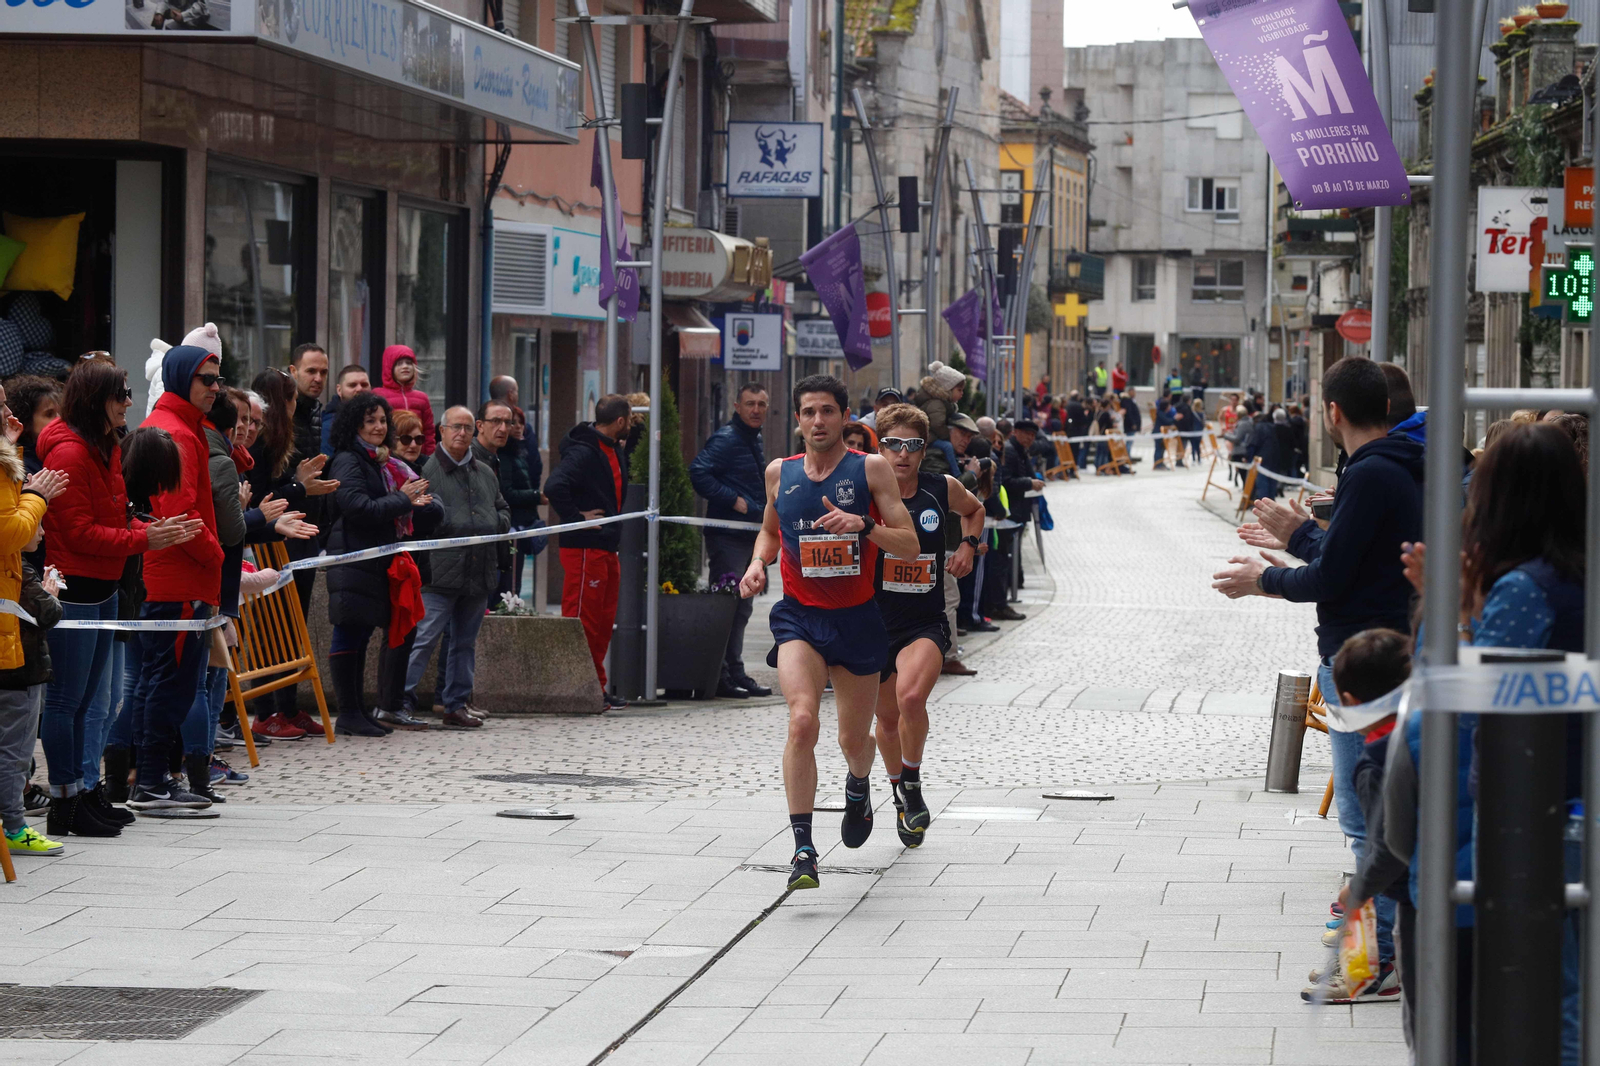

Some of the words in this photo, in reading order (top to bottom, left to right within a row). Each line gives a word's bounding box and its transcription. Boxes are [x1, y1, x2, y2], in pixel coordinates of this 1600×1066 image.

[1251, 7, 1296, 25] IGUALDADE
[1261, 17, 1296, 33] CULTURA
[1258, 22, 1310, 44] VISIBILIDADE
[1290, 131, 1304, 143] AS
[1305, 125, 1351, 140] MULLERES
[1352, 125, 1369, 136] FAN
[1296, 137, 1379, 167] PORRIÑO
[737, 171, 812, 184] RAFAGAS
[1312, 184, 1323, 194] DO
[1324, 181, 1331, 193] 8
[1333, 182, 1342, 192] AO
[1343, 180, 1354, 191] 13
[1355, 181, 1365, 191] DE
[1366, 179, 1390, 190] MARZO
[812, 547, 842, 566] 1145
[894, 565, 922, 583] 962
